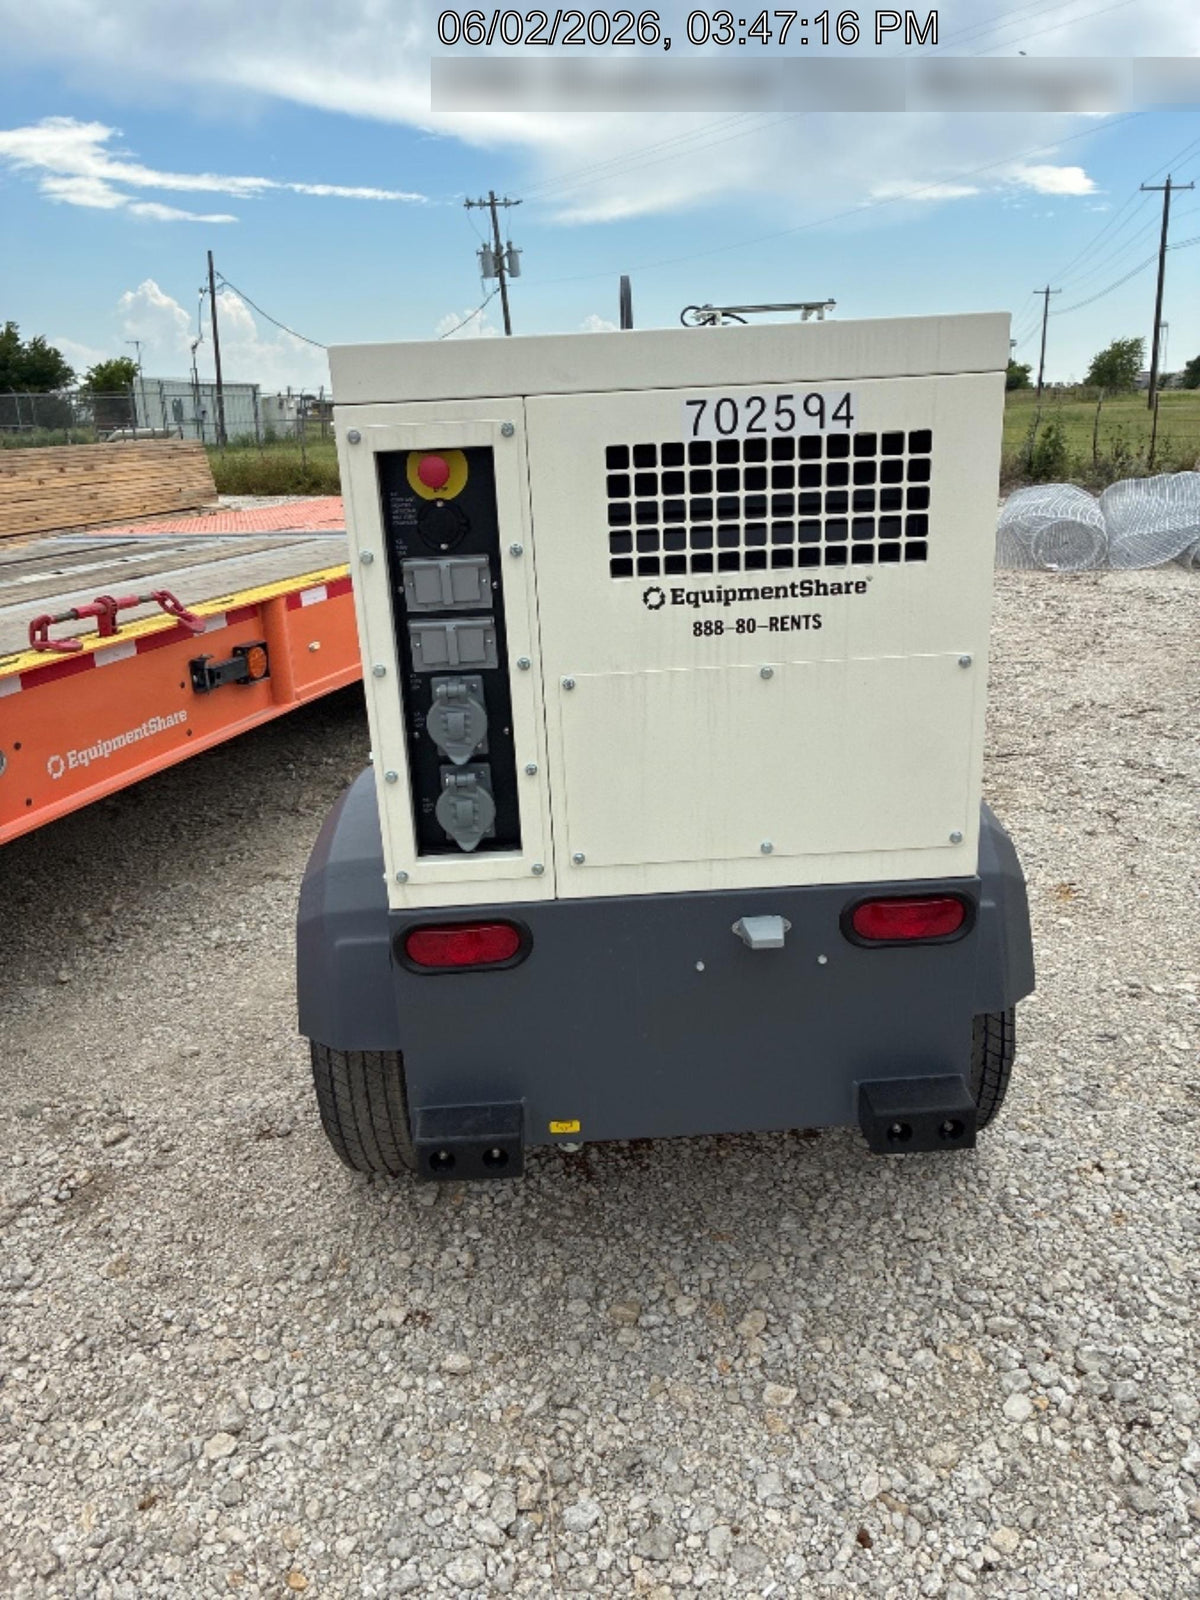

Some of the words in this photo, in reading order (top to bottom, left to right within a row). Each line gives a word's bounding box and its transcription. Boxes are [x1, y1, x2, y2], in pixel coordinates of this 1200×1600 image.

[685, 391, 855, 437] 702594
[669, 578, 868, 609] EquipmentShare
[692, 613, 823, 637] 888-80-RENTS
[67, 708, 188, 770] EquipmentShare
